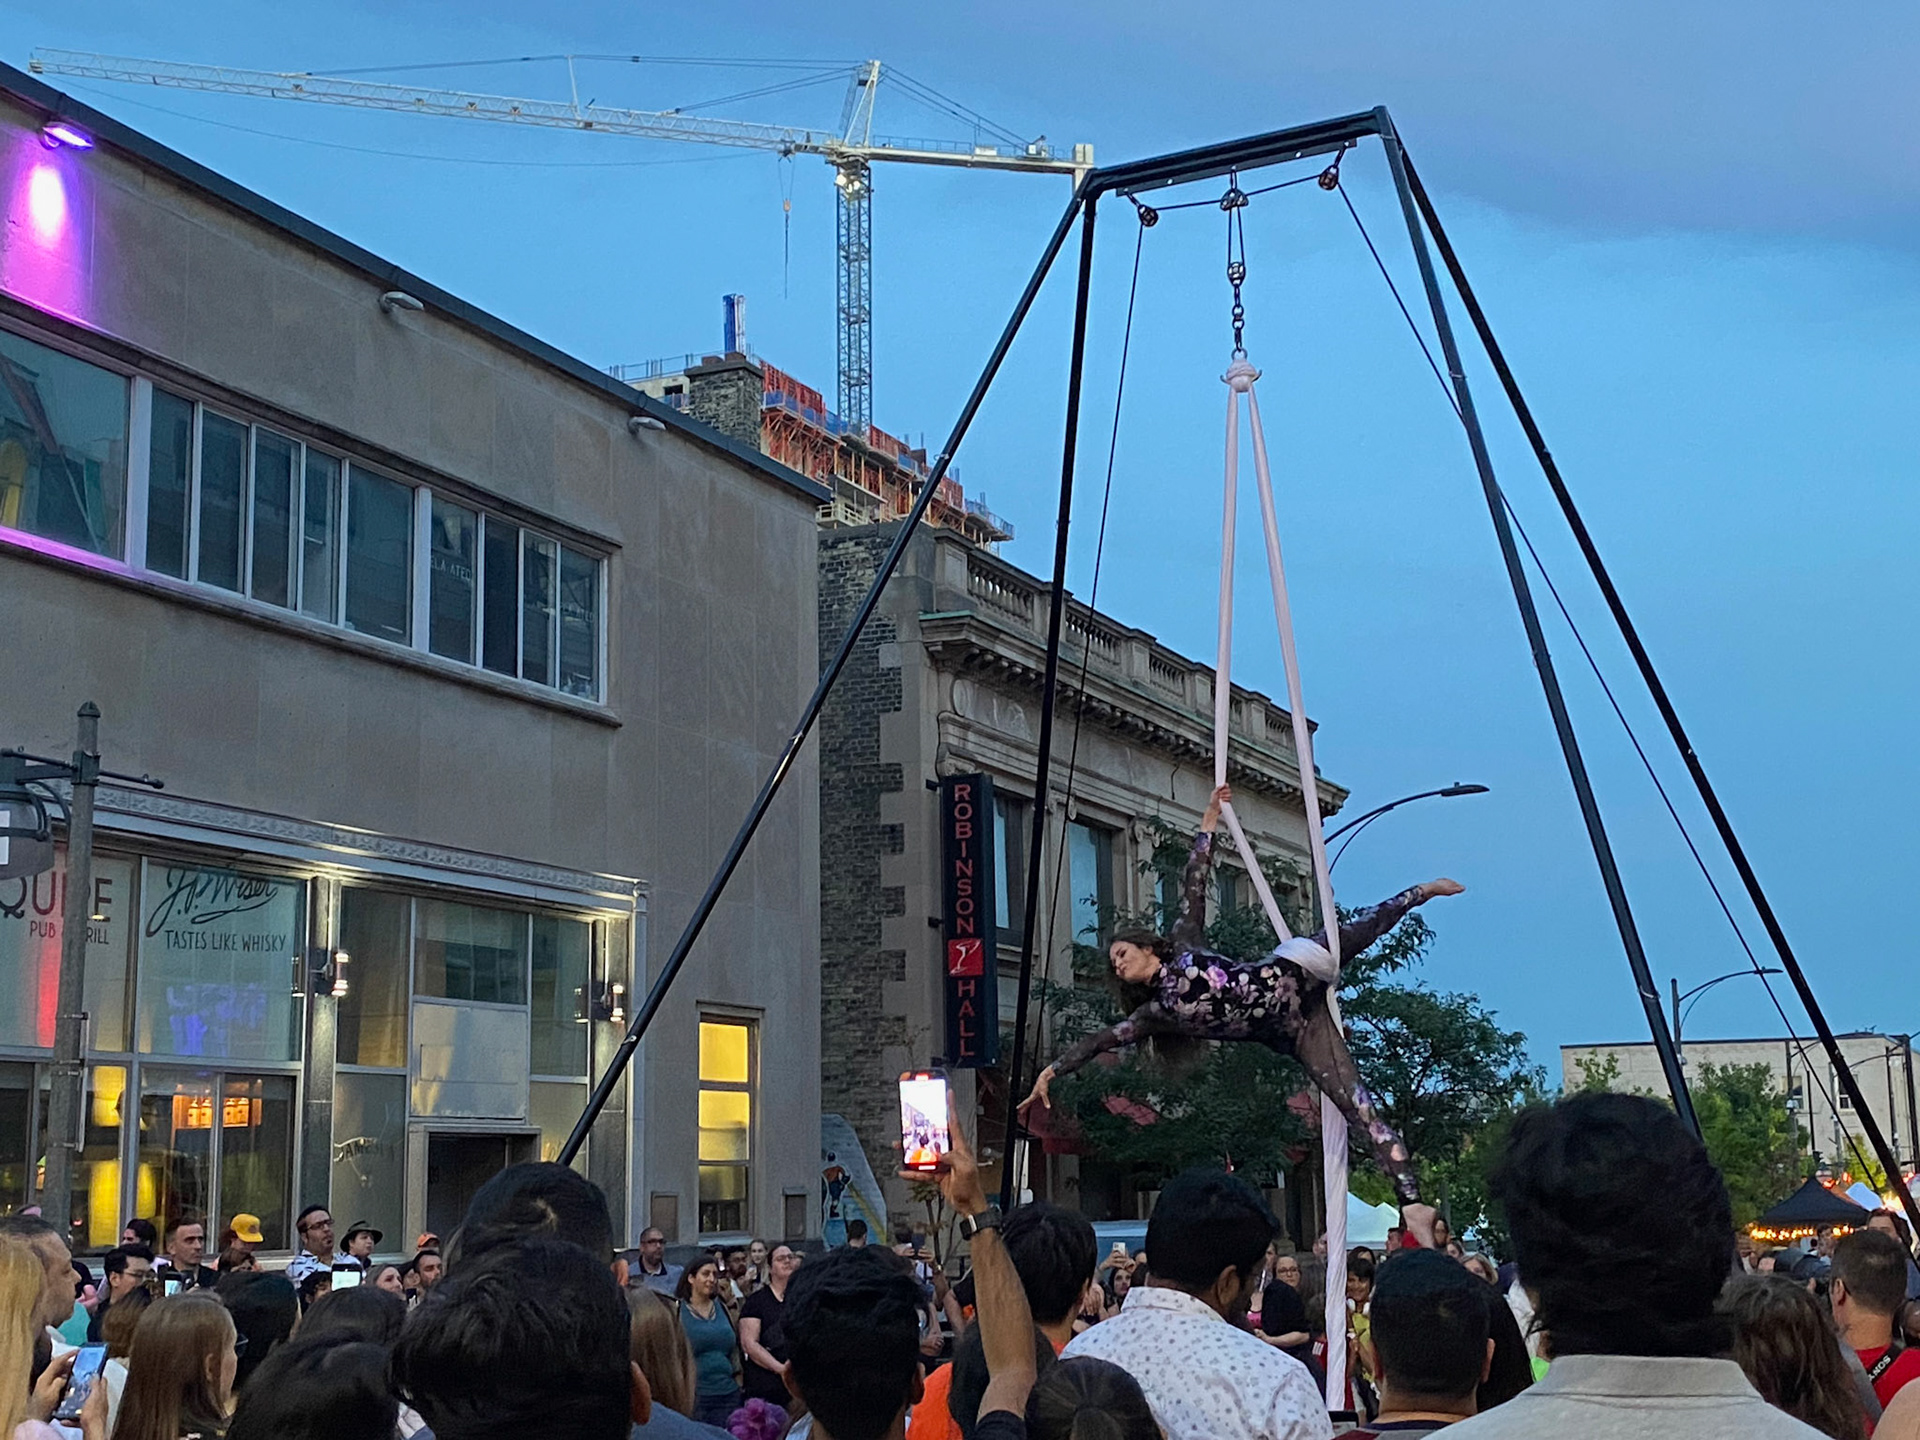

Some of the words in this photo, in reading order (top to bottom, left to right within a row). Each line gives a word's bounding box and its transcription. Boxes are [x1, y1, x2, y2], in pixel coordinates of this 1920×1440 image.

[954, 783, 975, 935] ROBINSON
[30, 920, 56, 939] PUB
[86, 927, 110, 945] RILL
[165, 930, 207, 950] TASTES
[212, 932, 238, 951] LIKE
[242, 934, 287, 952] WHISKY
[957, 980, 976, 1057] HALL
